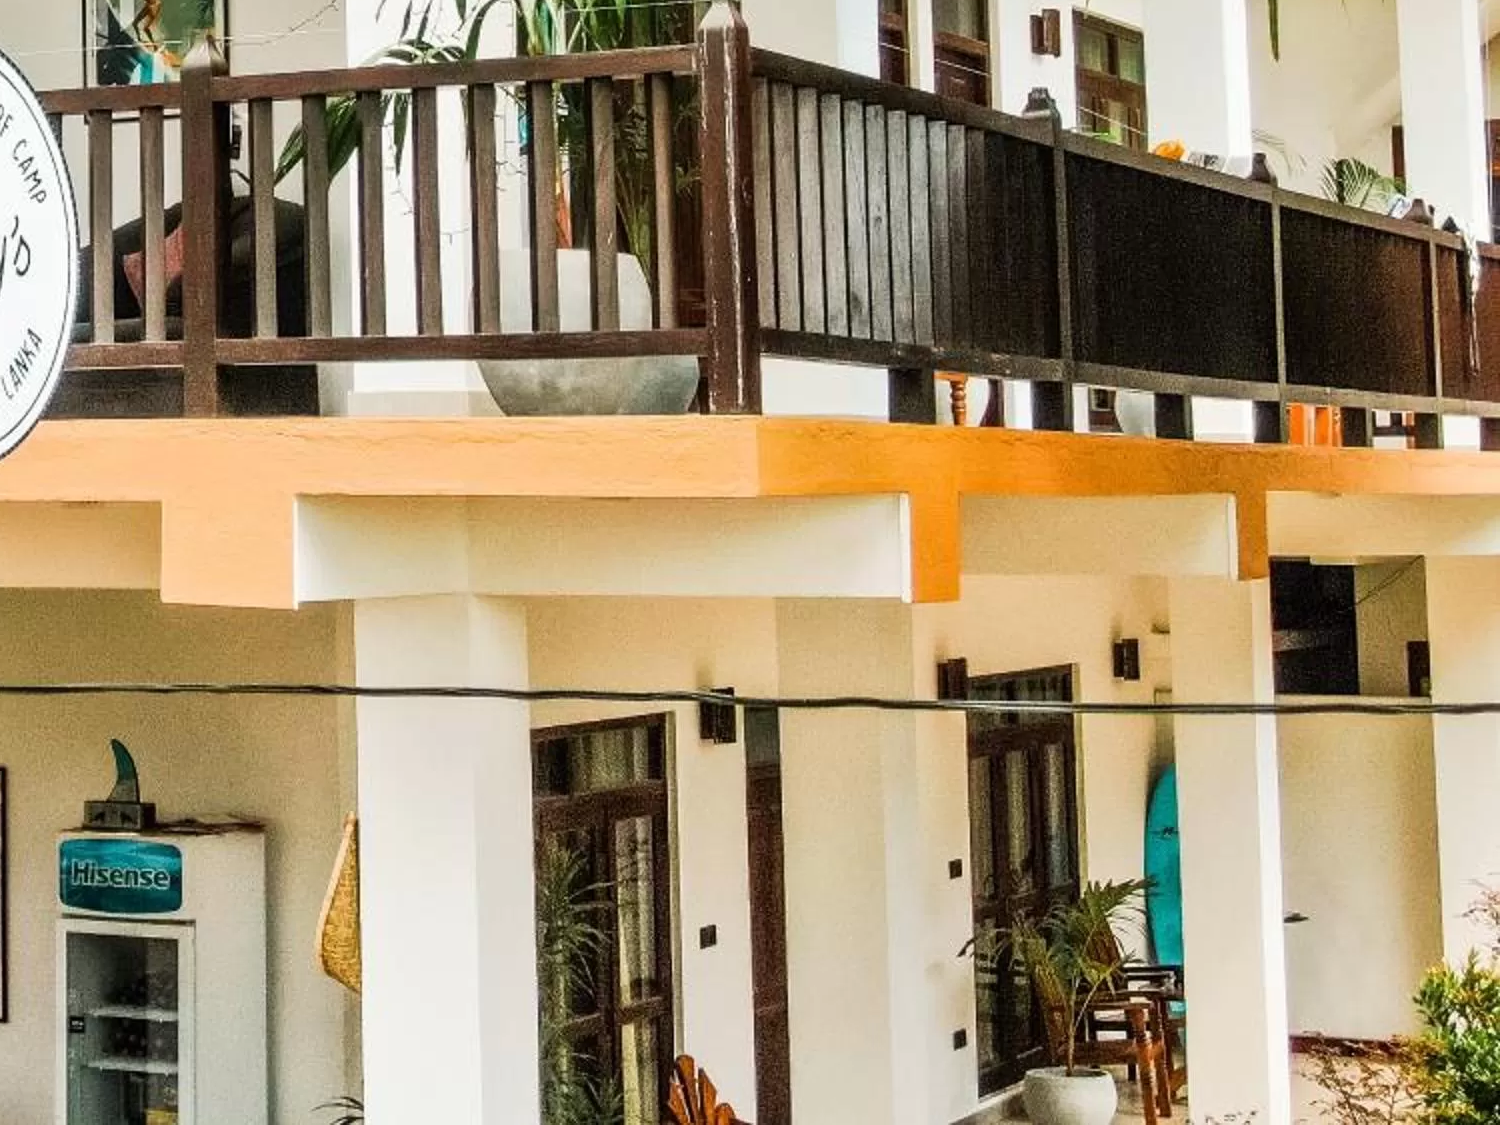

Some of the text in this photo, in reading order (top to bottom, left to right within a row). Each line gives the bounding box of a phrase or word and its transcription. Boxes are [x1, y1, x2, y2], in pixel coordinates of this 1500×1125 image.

[12, 139, 47, 204] CAMP
[0, 327, 43, 400] LANKA
[71, 858, 171, 890] Hisense
